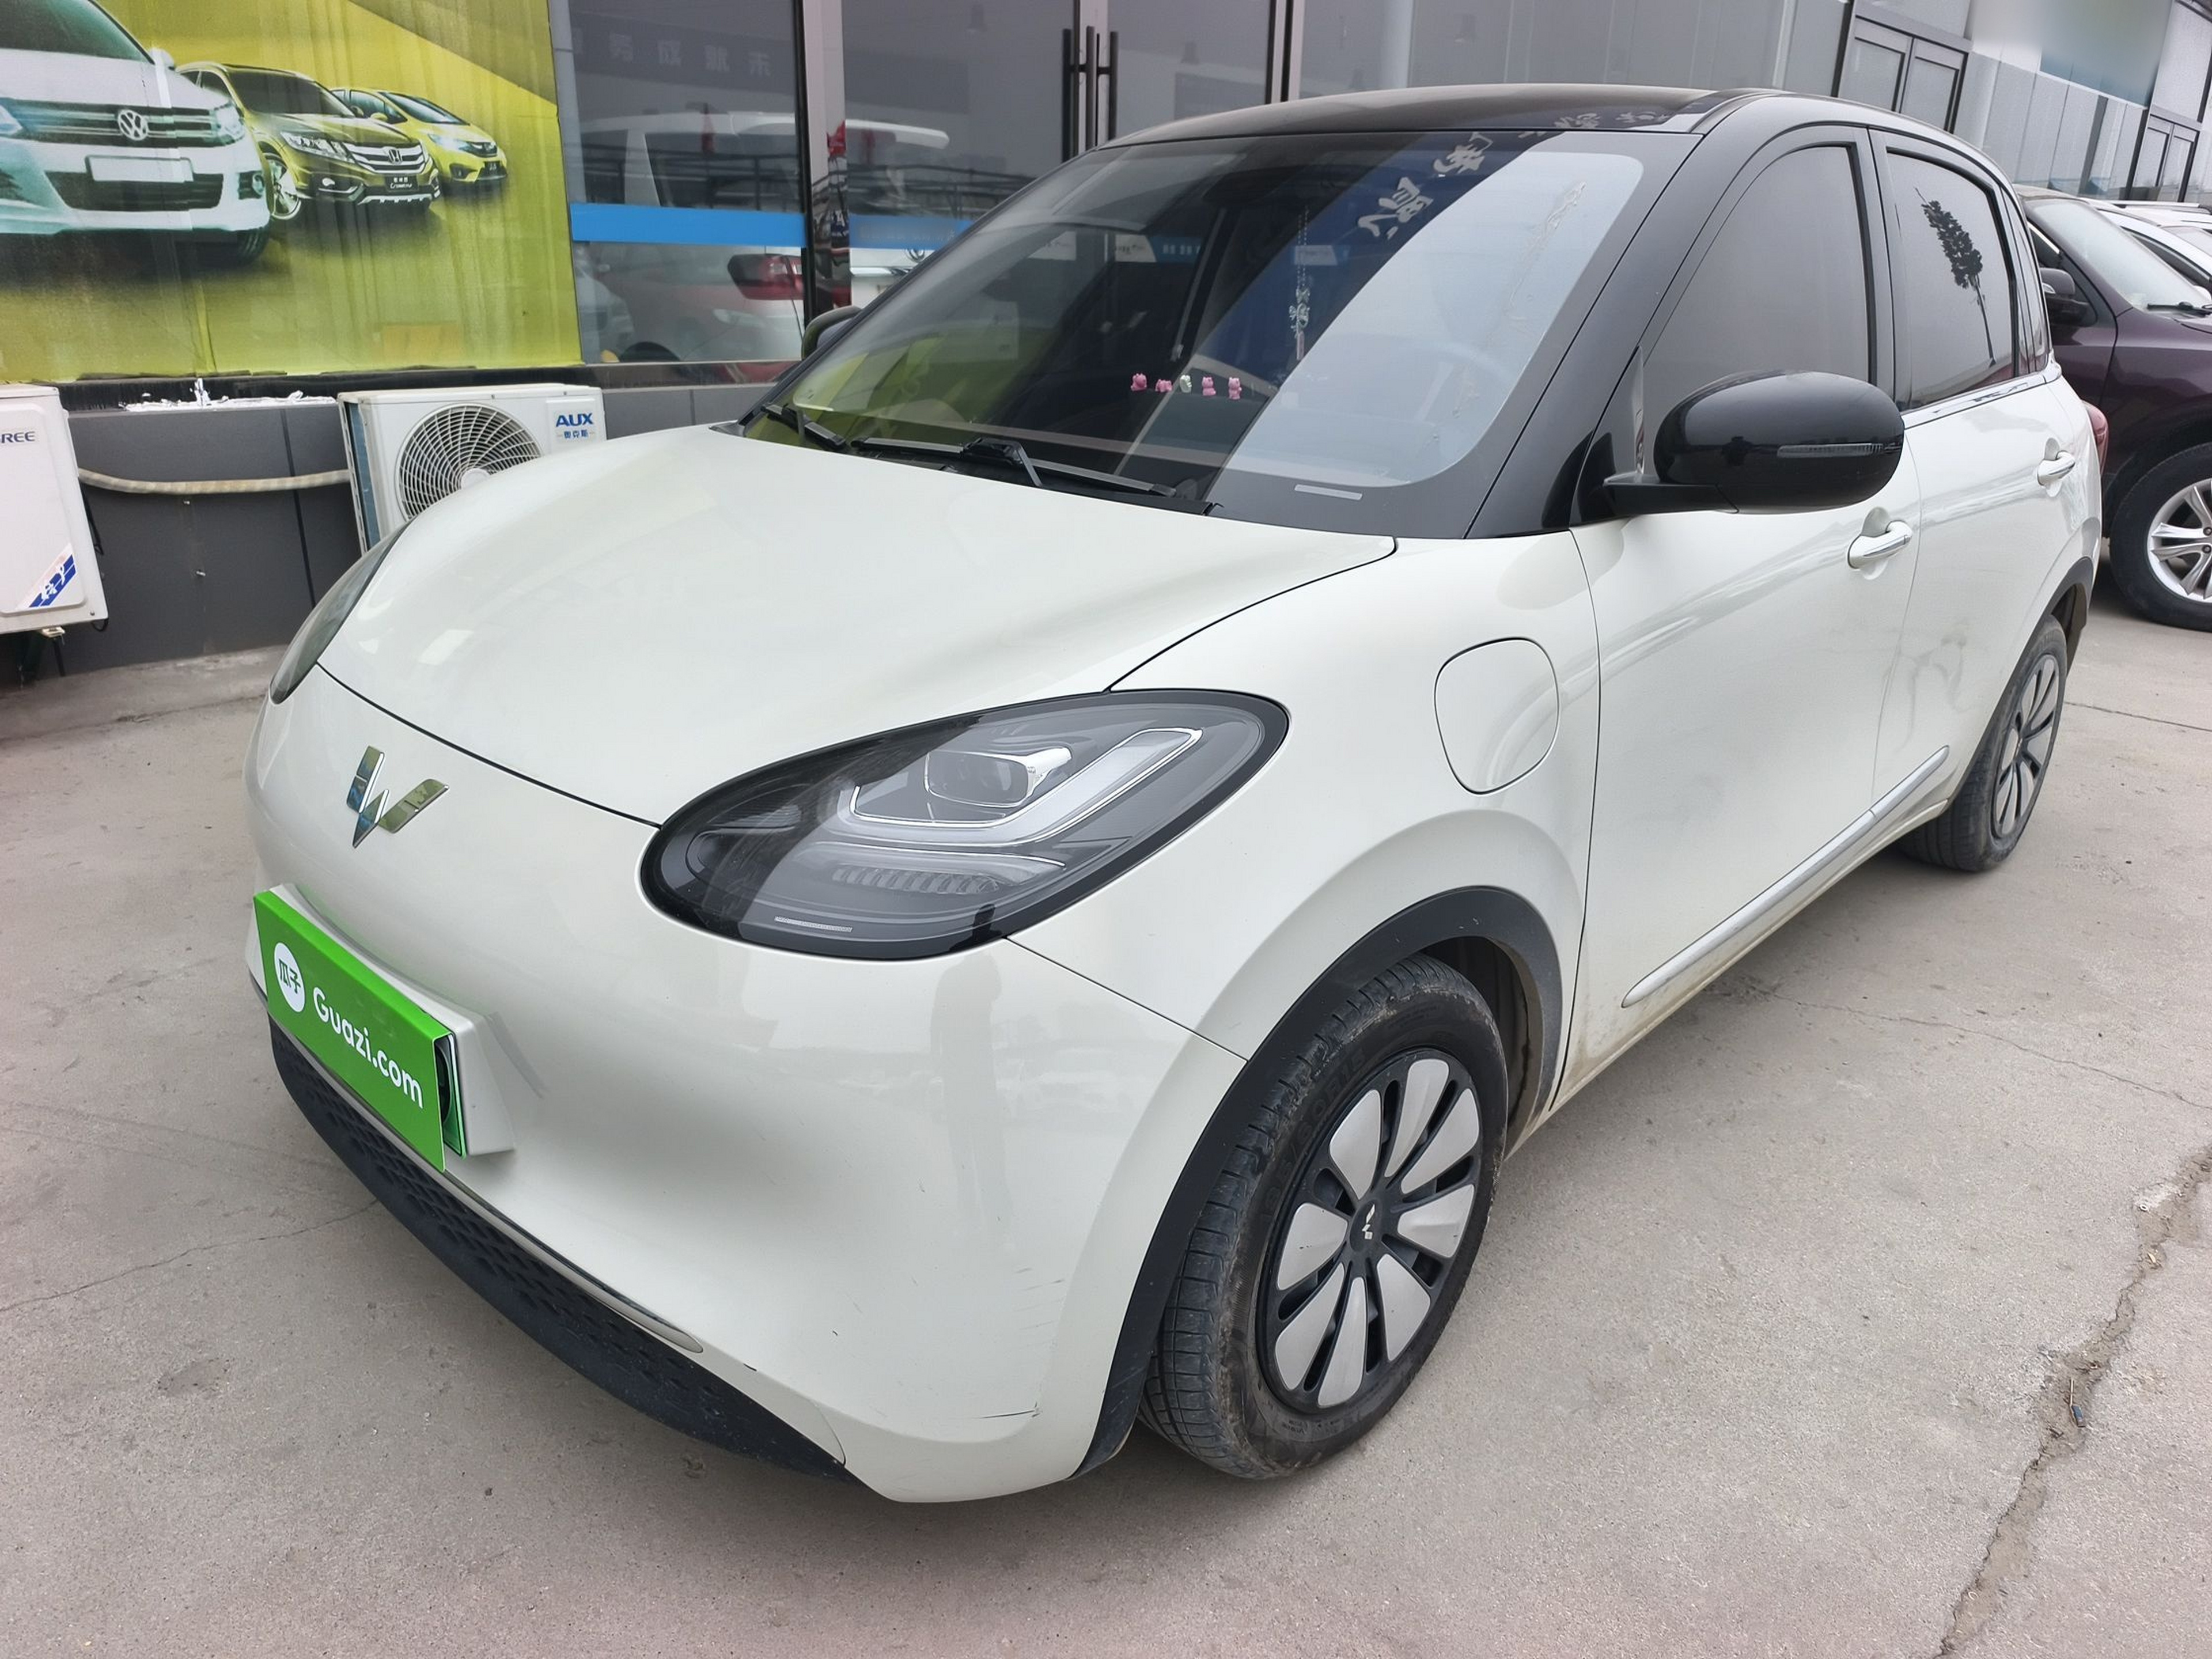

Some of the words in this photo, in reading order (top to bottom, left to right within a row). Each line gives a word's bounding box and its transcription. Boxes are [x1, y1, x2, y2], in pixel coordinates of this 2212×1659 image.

[556, 413, 593, 427] AUX
[0, 431, 35, 444] REE
[278, 959, 301, 994] 瓜子
[313, 987, 423, 1109] Guazi.com
